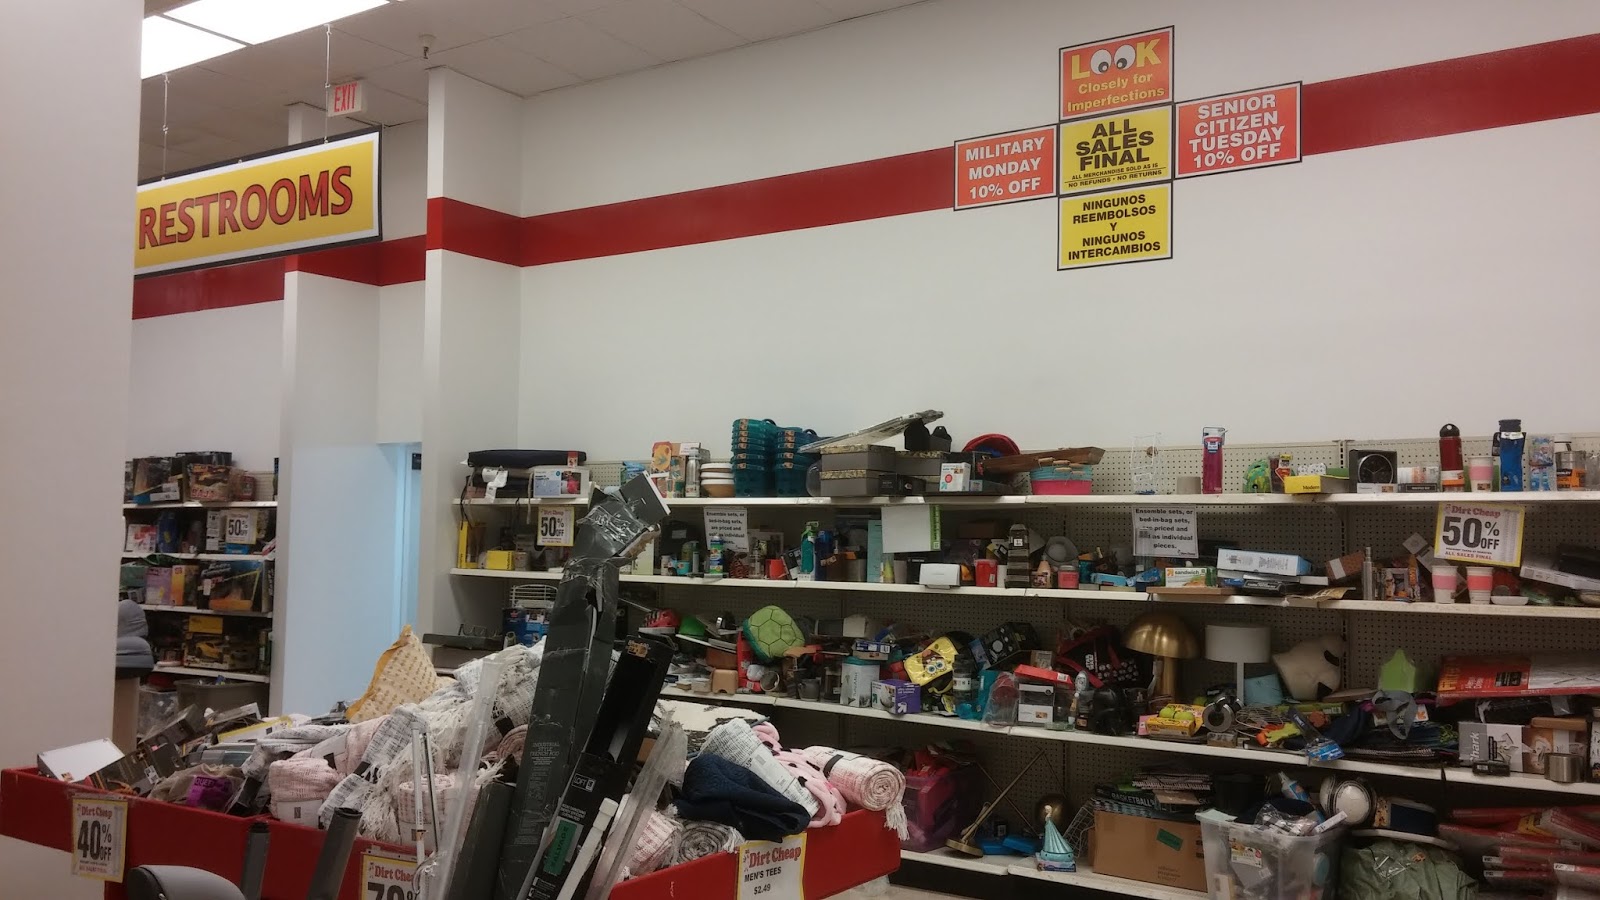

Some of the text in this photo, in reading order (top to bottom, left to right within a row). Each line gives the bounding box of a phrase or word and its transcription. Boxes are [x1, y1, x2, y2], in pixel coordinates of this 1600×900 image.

[1071, 38, 1162, 80] LOOK
[1078, 73, 1153, 94] Closely for
[334, 82, 358, 112] EXIT
[1067, 88, 1165, 112] Imperfections
[1198, 94, 1276, 119] SENIOR
[1092, 118, 1137, 139] ALL
[1194, 110, 1278, 136] CITIZEN
[966, 136, 1046, 162] MILITARY
[1076, 130, 1154, 156] SALES
[1189, 125, 1285, 153] TUESDAY
[1080, 148, 1150, 171] FINAL
[1194, 142, 1281, 168] 10% OFF
[968, 157, 1041, 180] MONDAY
[1080, 177, 1111, 186] REFUNDS
[1130, 169, 1162, 179] RETURNS
[1083, 168, 1124, 178] MERCHANDISE
[969, 177, 1041, 200] 10% OFF
[138, 165, 353, 250] RESTROOMS
[1082, 194, 1146, 211] NINGUNOS
[1072, 205, 1156, 224] REEMBOLSOS
[1110, 222, 1117, 232] Y
[1082, 231, 1146, 247] NINGUNOS
[1068, 241, 1161, 260] INTERCAMBIOS
[1452, 505, 1501, 518] Dirt Cheap
[541, 516, 564, 537] 50%
[555, 529, 564, 537] OFF
[1442, 516, 1500, 548] 50%
[1480, 538, 1500, 550] OFF
[81, 806, 112, 819] Dirt Cheap
[78, 820, 112, 860] 40%
[100, 846, 112, 861] OFF
[749, 846, 801, 868] Dirt Cheap
[375, 865, 414, 882] Dirt Chea
[744, 866, 782, 882] MEN'S TEES
[753, 883, 771, 895] $2.49
